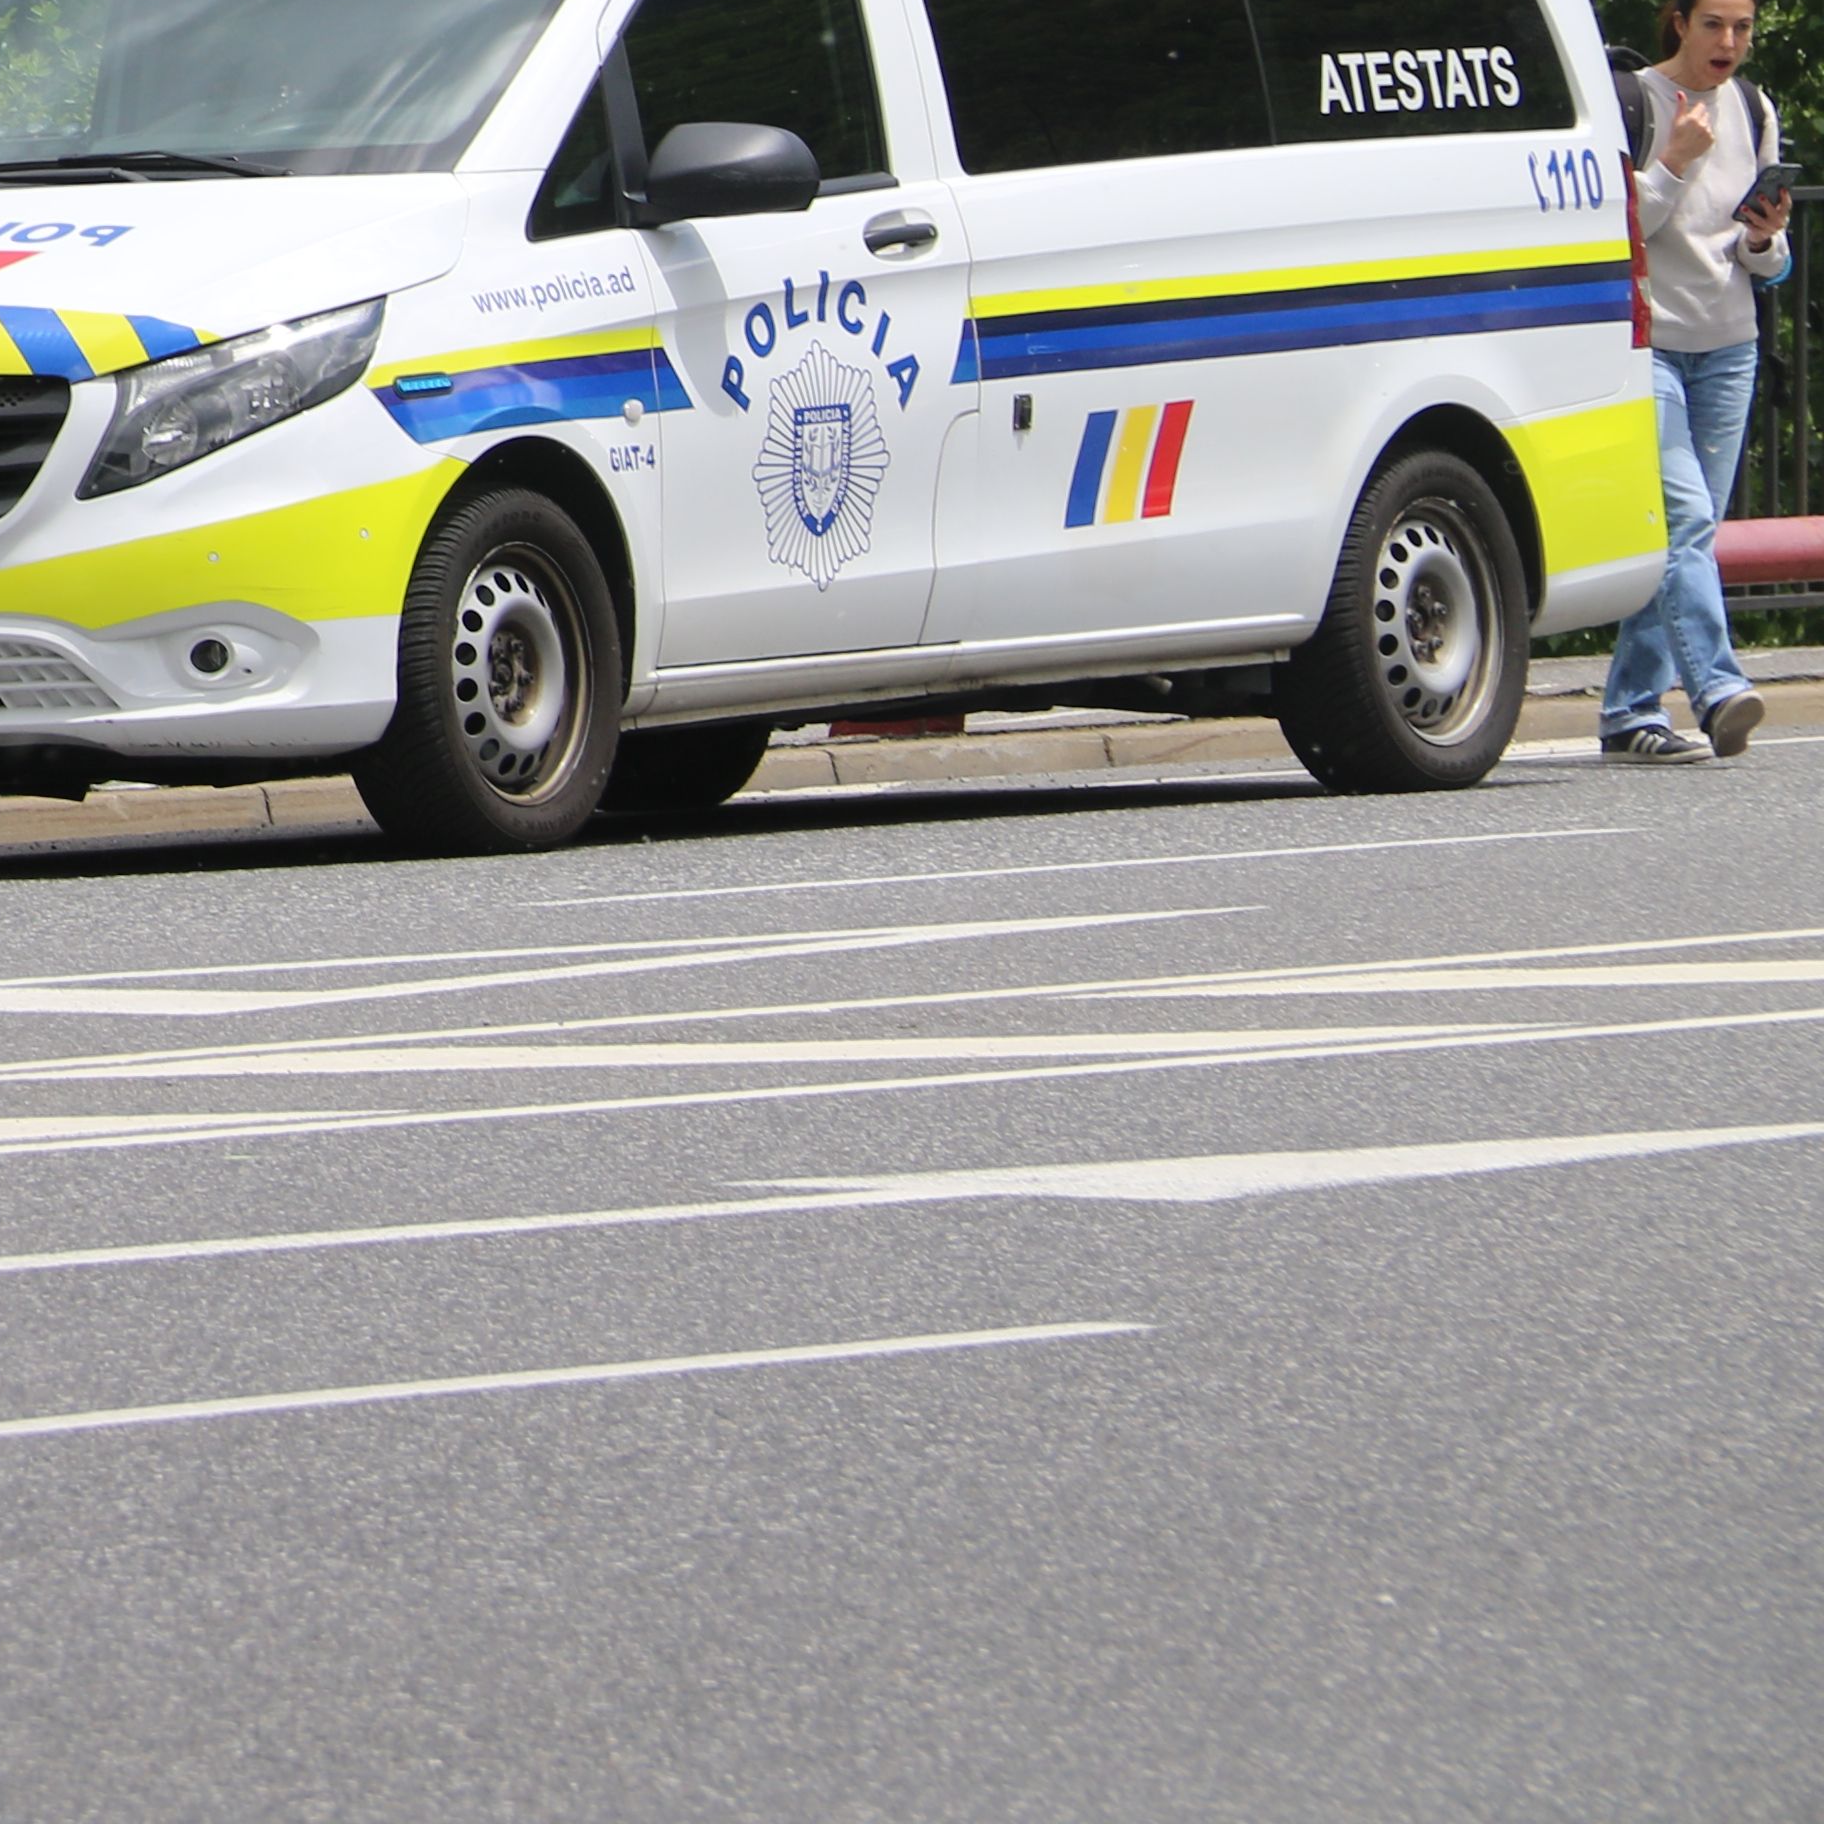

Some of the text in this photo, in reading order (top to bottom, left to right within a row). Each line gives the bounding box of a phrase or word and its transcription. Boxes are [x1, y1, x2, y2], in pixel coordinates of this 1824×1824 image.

[1319, 46, 1520, 115] ATESTATS
[1547, 149, 1603, 210] 110
[472, 265, 636, 313] www.policia.ad
[721, 270, 921, 413] POLICIA
[609, 444, 656, 473] GIAT-4
